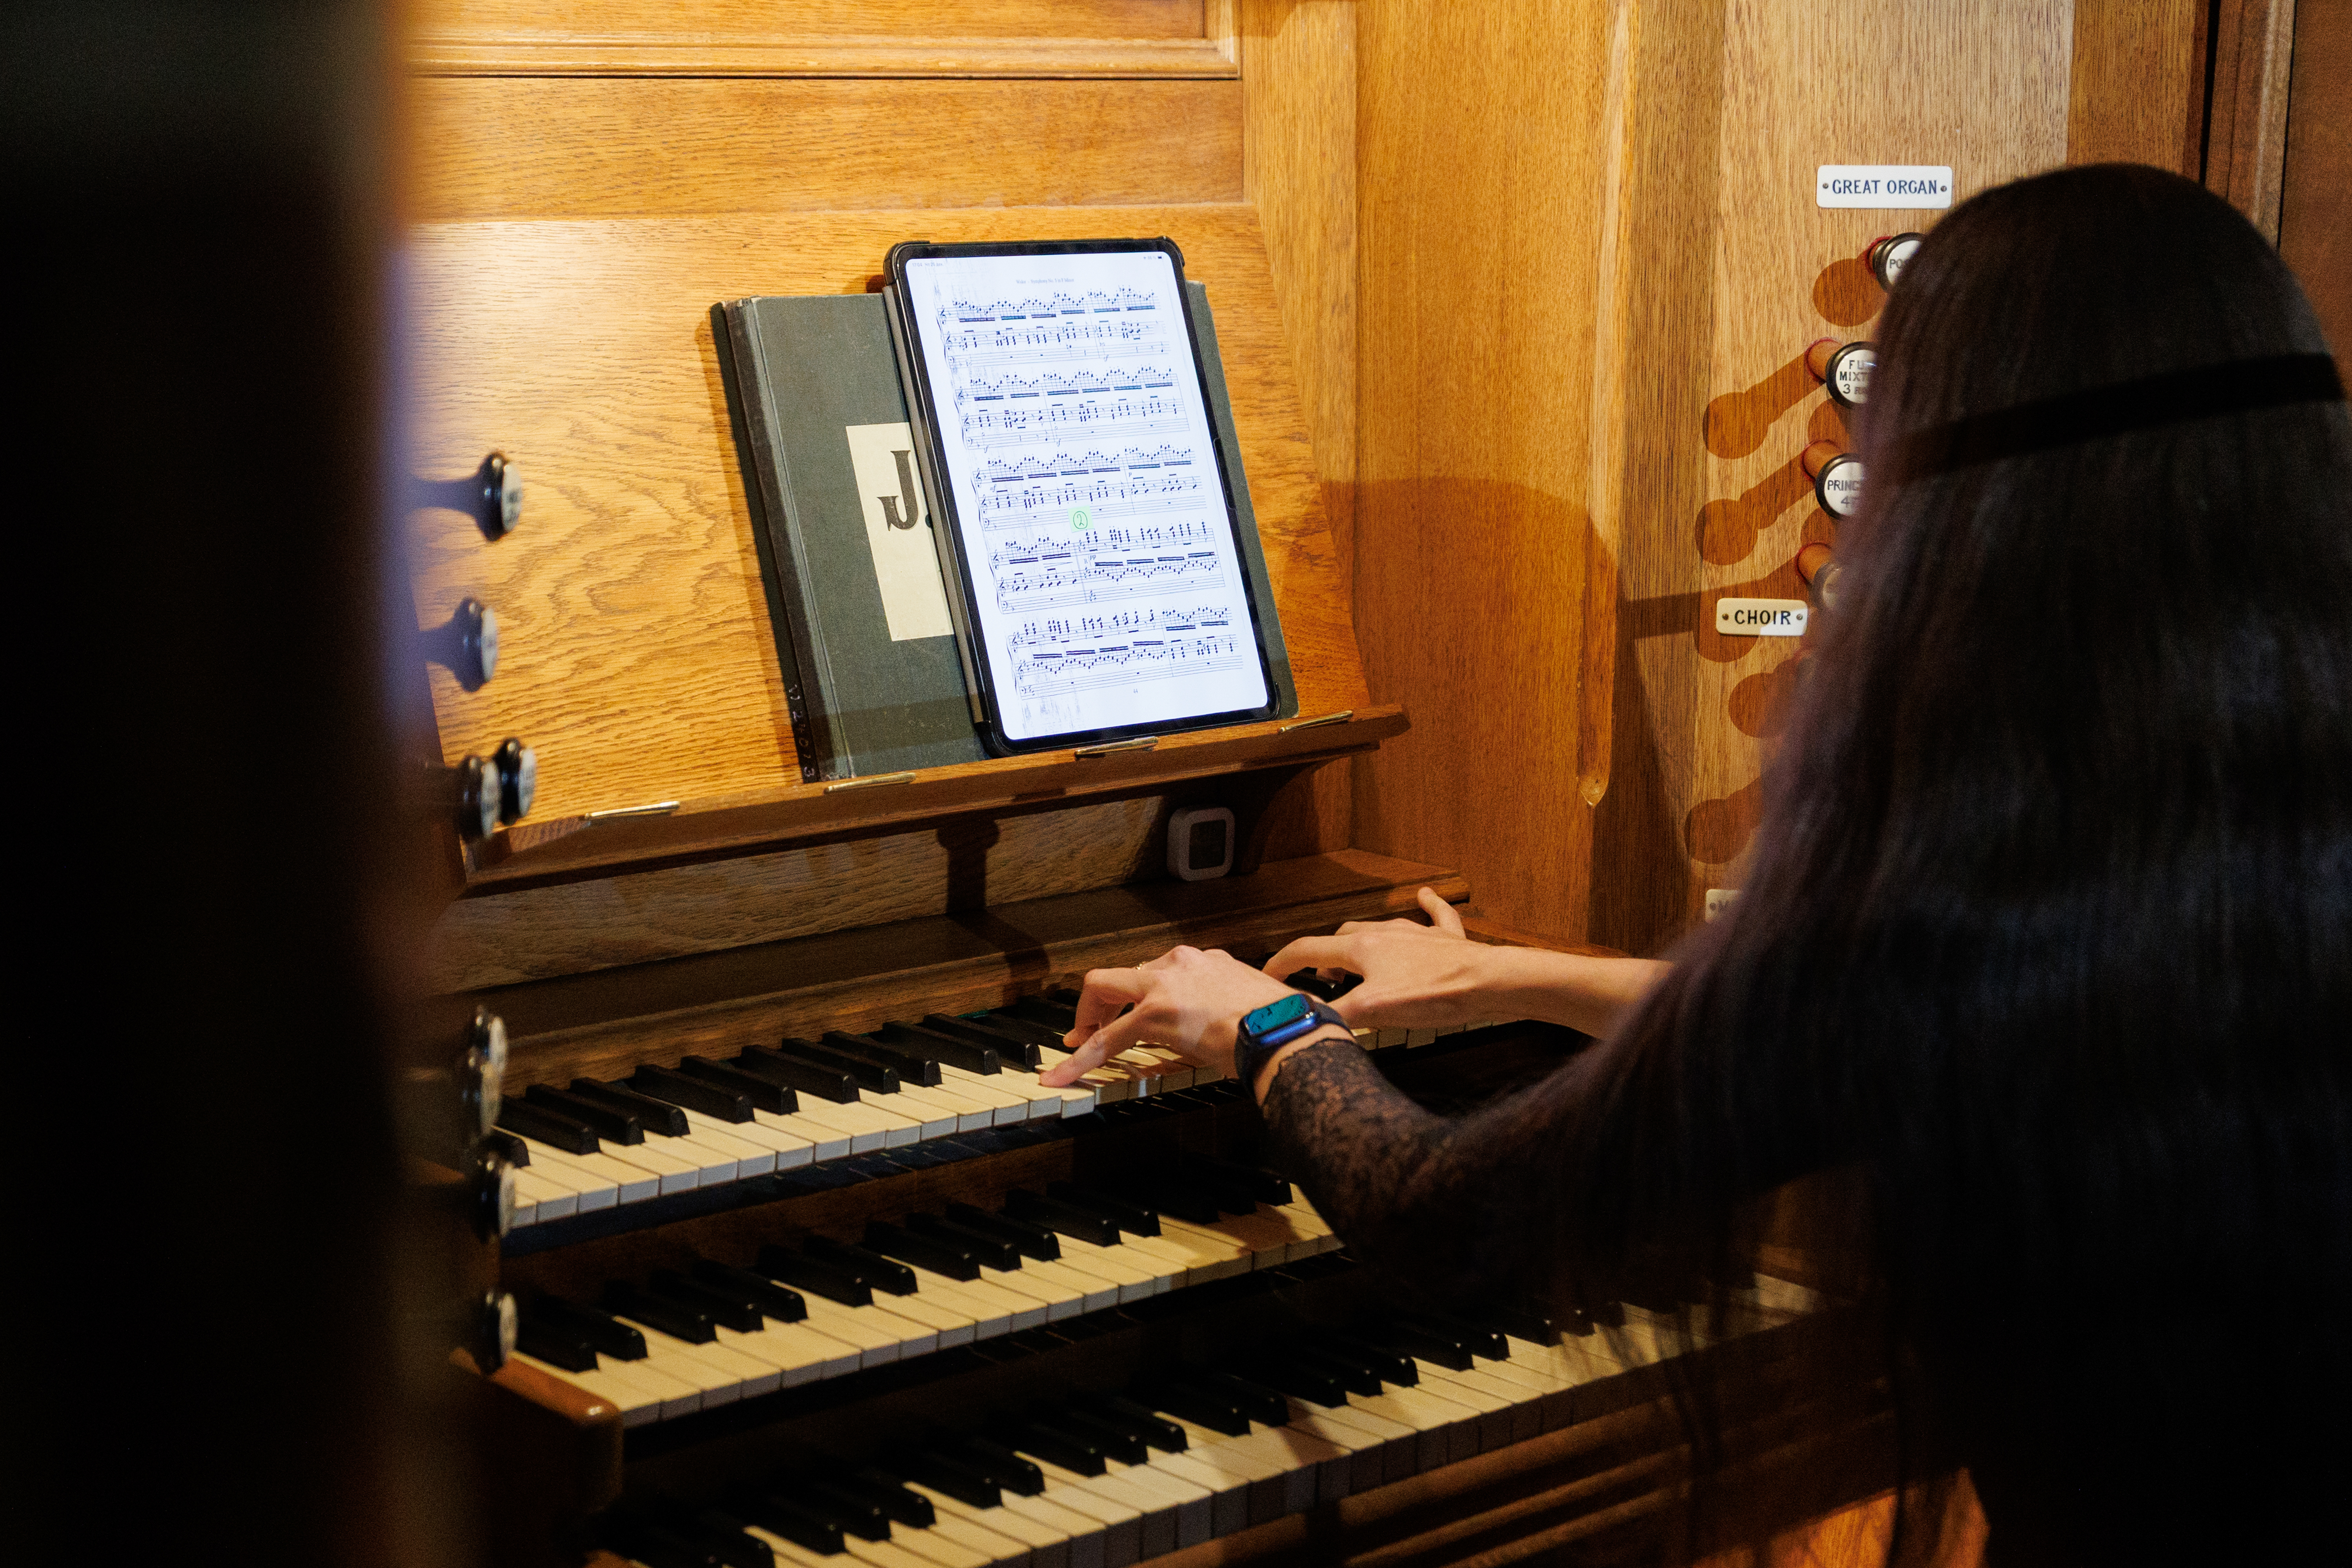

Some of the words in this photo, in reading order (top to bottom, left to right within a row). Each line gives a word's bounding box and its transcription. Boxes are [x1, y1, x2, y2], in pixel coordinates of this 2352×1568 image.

[1832, 179, 1880, 194] GREAT
[1887, 180, 1937, 194] ORGAN
[1839, 371, 1867, 381] MIXT
[1842, 383, 1851, 394] 3
[1827, 479, 1859, 491] PRINC
[1076, 514, 1084, 526] 2
[1735, 610, 1791, 625] CHOIR
